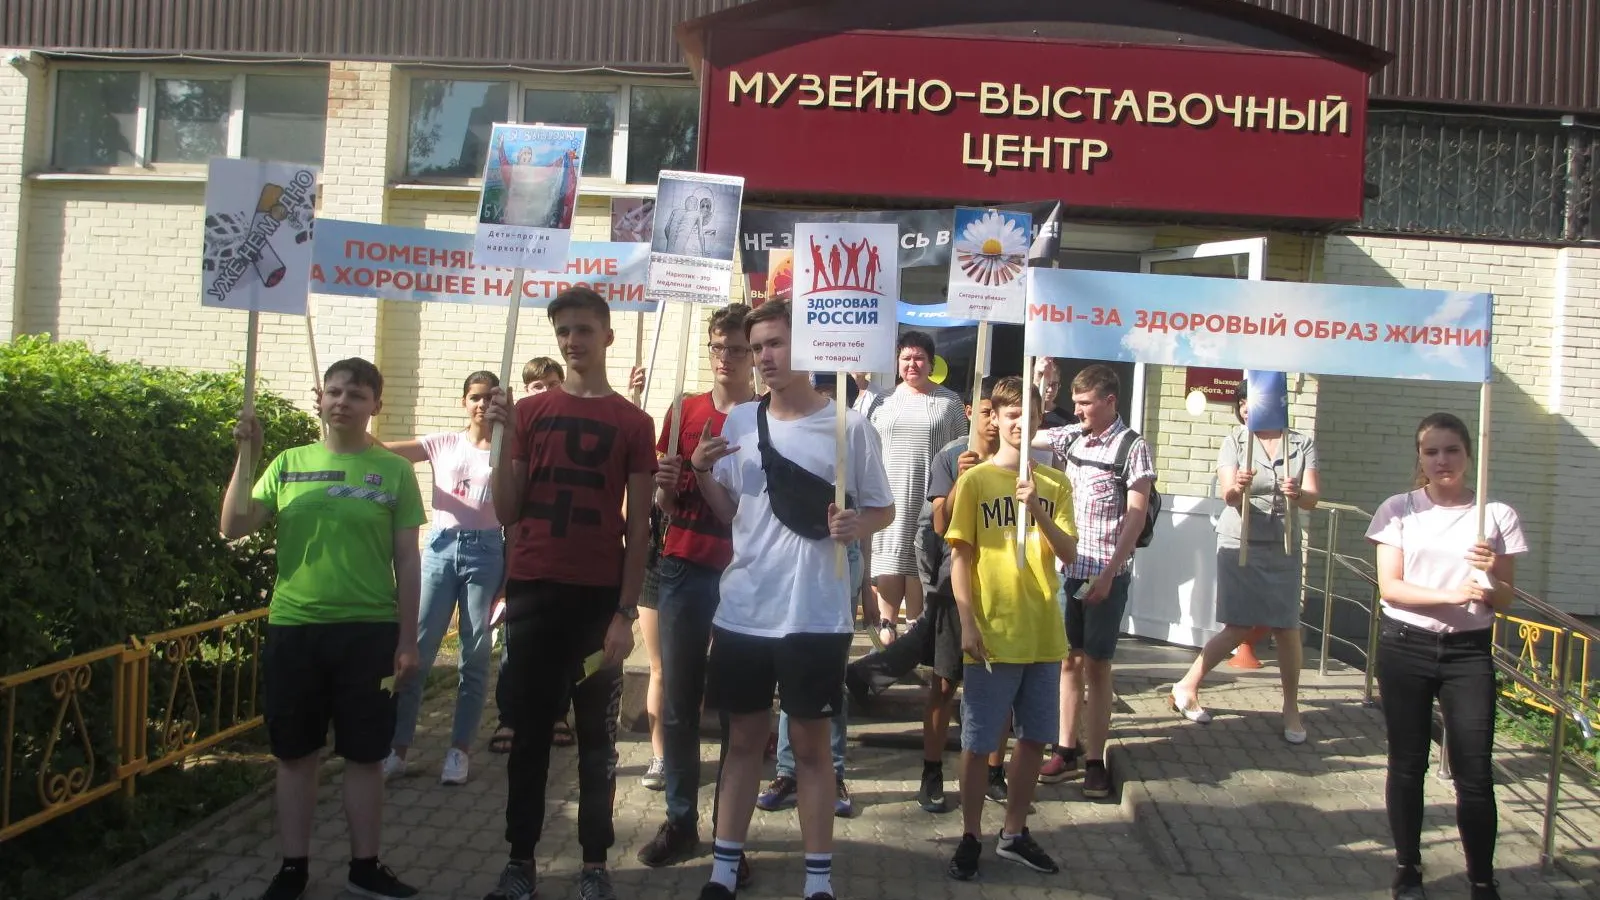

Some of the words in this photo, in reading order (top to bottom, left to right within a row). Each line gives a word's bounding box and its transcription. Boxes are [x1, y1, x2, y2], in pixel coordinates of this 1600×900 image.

[728, 70, 1348, 133] МУЗЕЙНО-ВЫСТАВОЧНЫЙ
[962, 132, 1109, 173] ЦЕНТР
[744, 232, 774, 251] НЕ
[208, 257, 247, 302] УЖЕ
[238, 231, 270, 262] НЕ
[334, 265, 477, 295] ХОРОШЕЕ
[807, 298, 879, 311] ЗДОРОВАЯ
[807, 311, 879, 325] РОССИЯ
[1134, 309, 1287, 337] ЗДОРОВЫЙ
[1294, 319, 1378, 342] ОБРАЗ
[1384, 323, 1491, 347] ЖИЗНИ!
[812, 340, 846, 349] Сигарета
[848, 341, 865, 349] тебе
[825, 354, 861, 364] товарищ!
